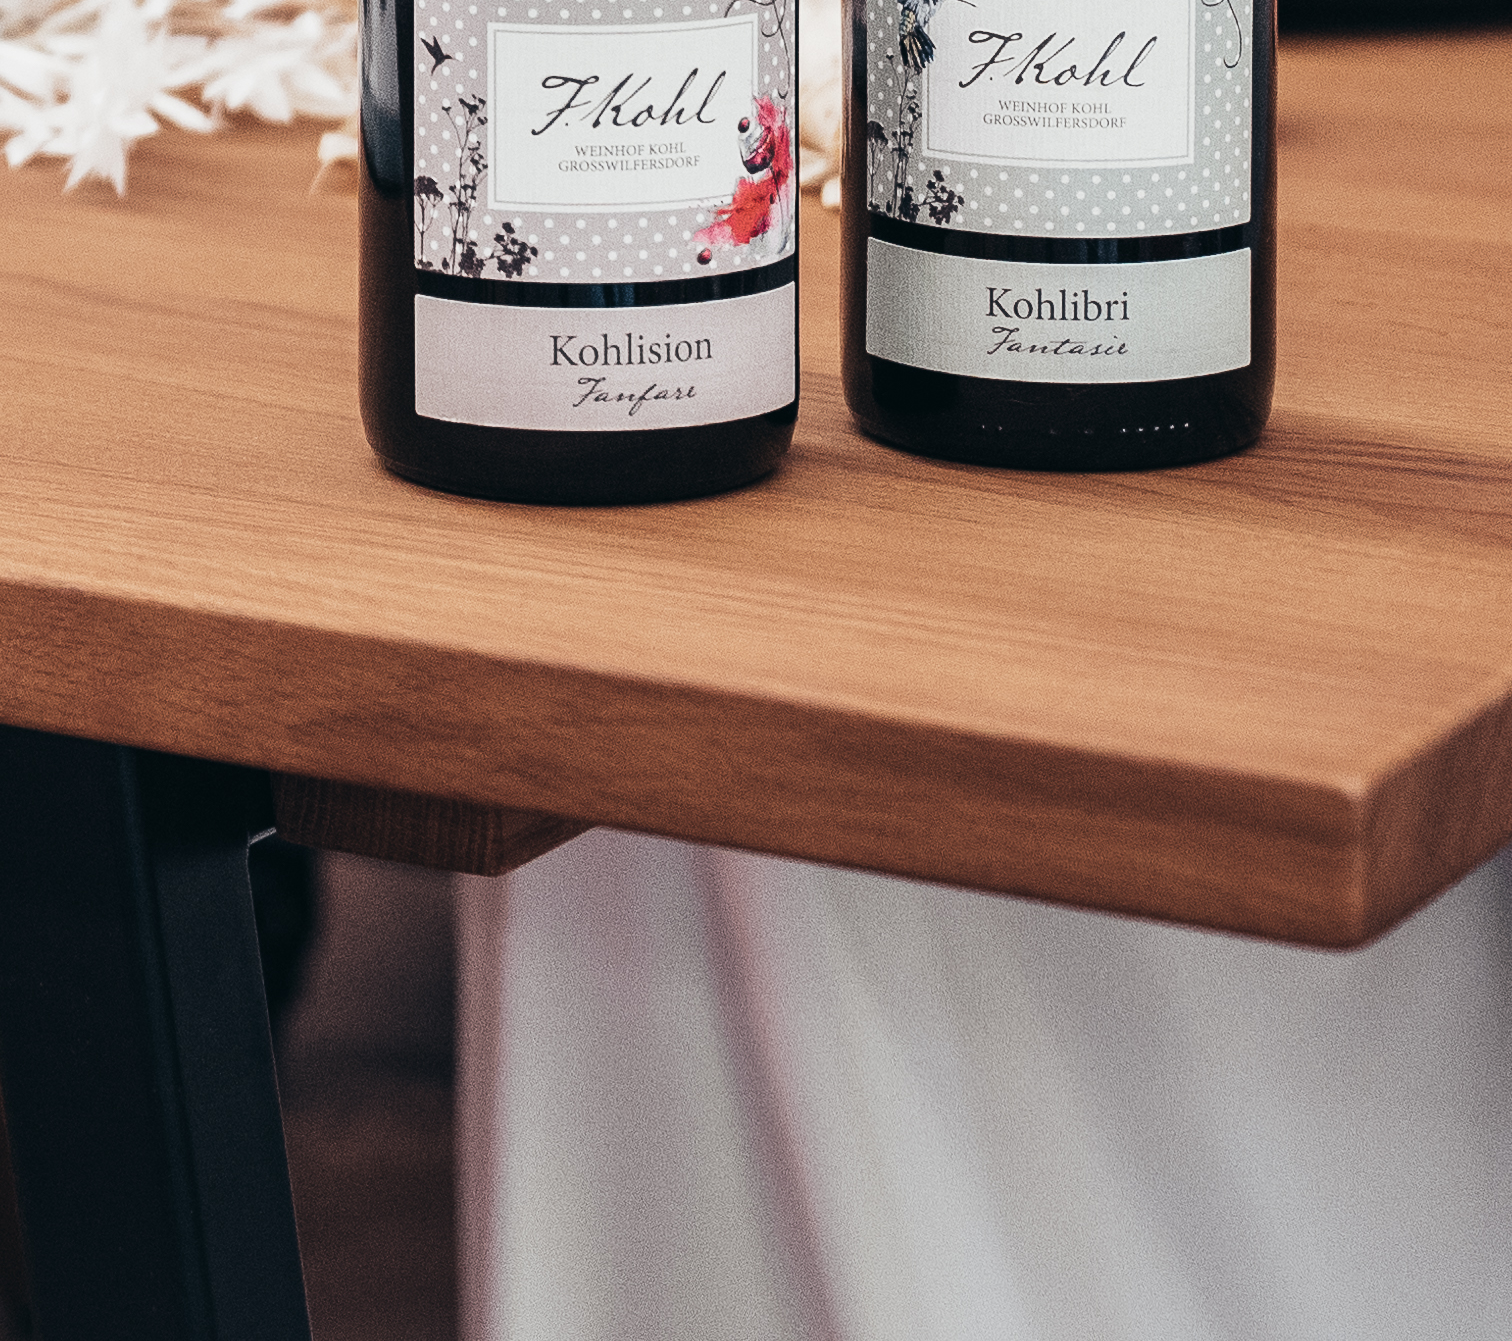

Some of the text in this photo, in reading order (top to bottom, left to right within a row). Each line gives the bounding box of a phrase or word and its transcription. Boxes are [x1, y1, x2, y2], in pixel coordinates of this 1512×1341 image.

[997, 99, 1111, 114] WEINHOF KOHL
[982, 113, 1127, 129] GROSSWILFERSDORF
[574, 141, 686, 157] WEINHOF KOHL
[557, 155, 701, 172] GROSSWILFERSDORF
[985, 285, 1130, 322] Kohlibri
[549, 332, 714, 367] Kohlision
[985, 326, 1129, 357] Fantasie
[571, 375, 696, 416] Fanfare
